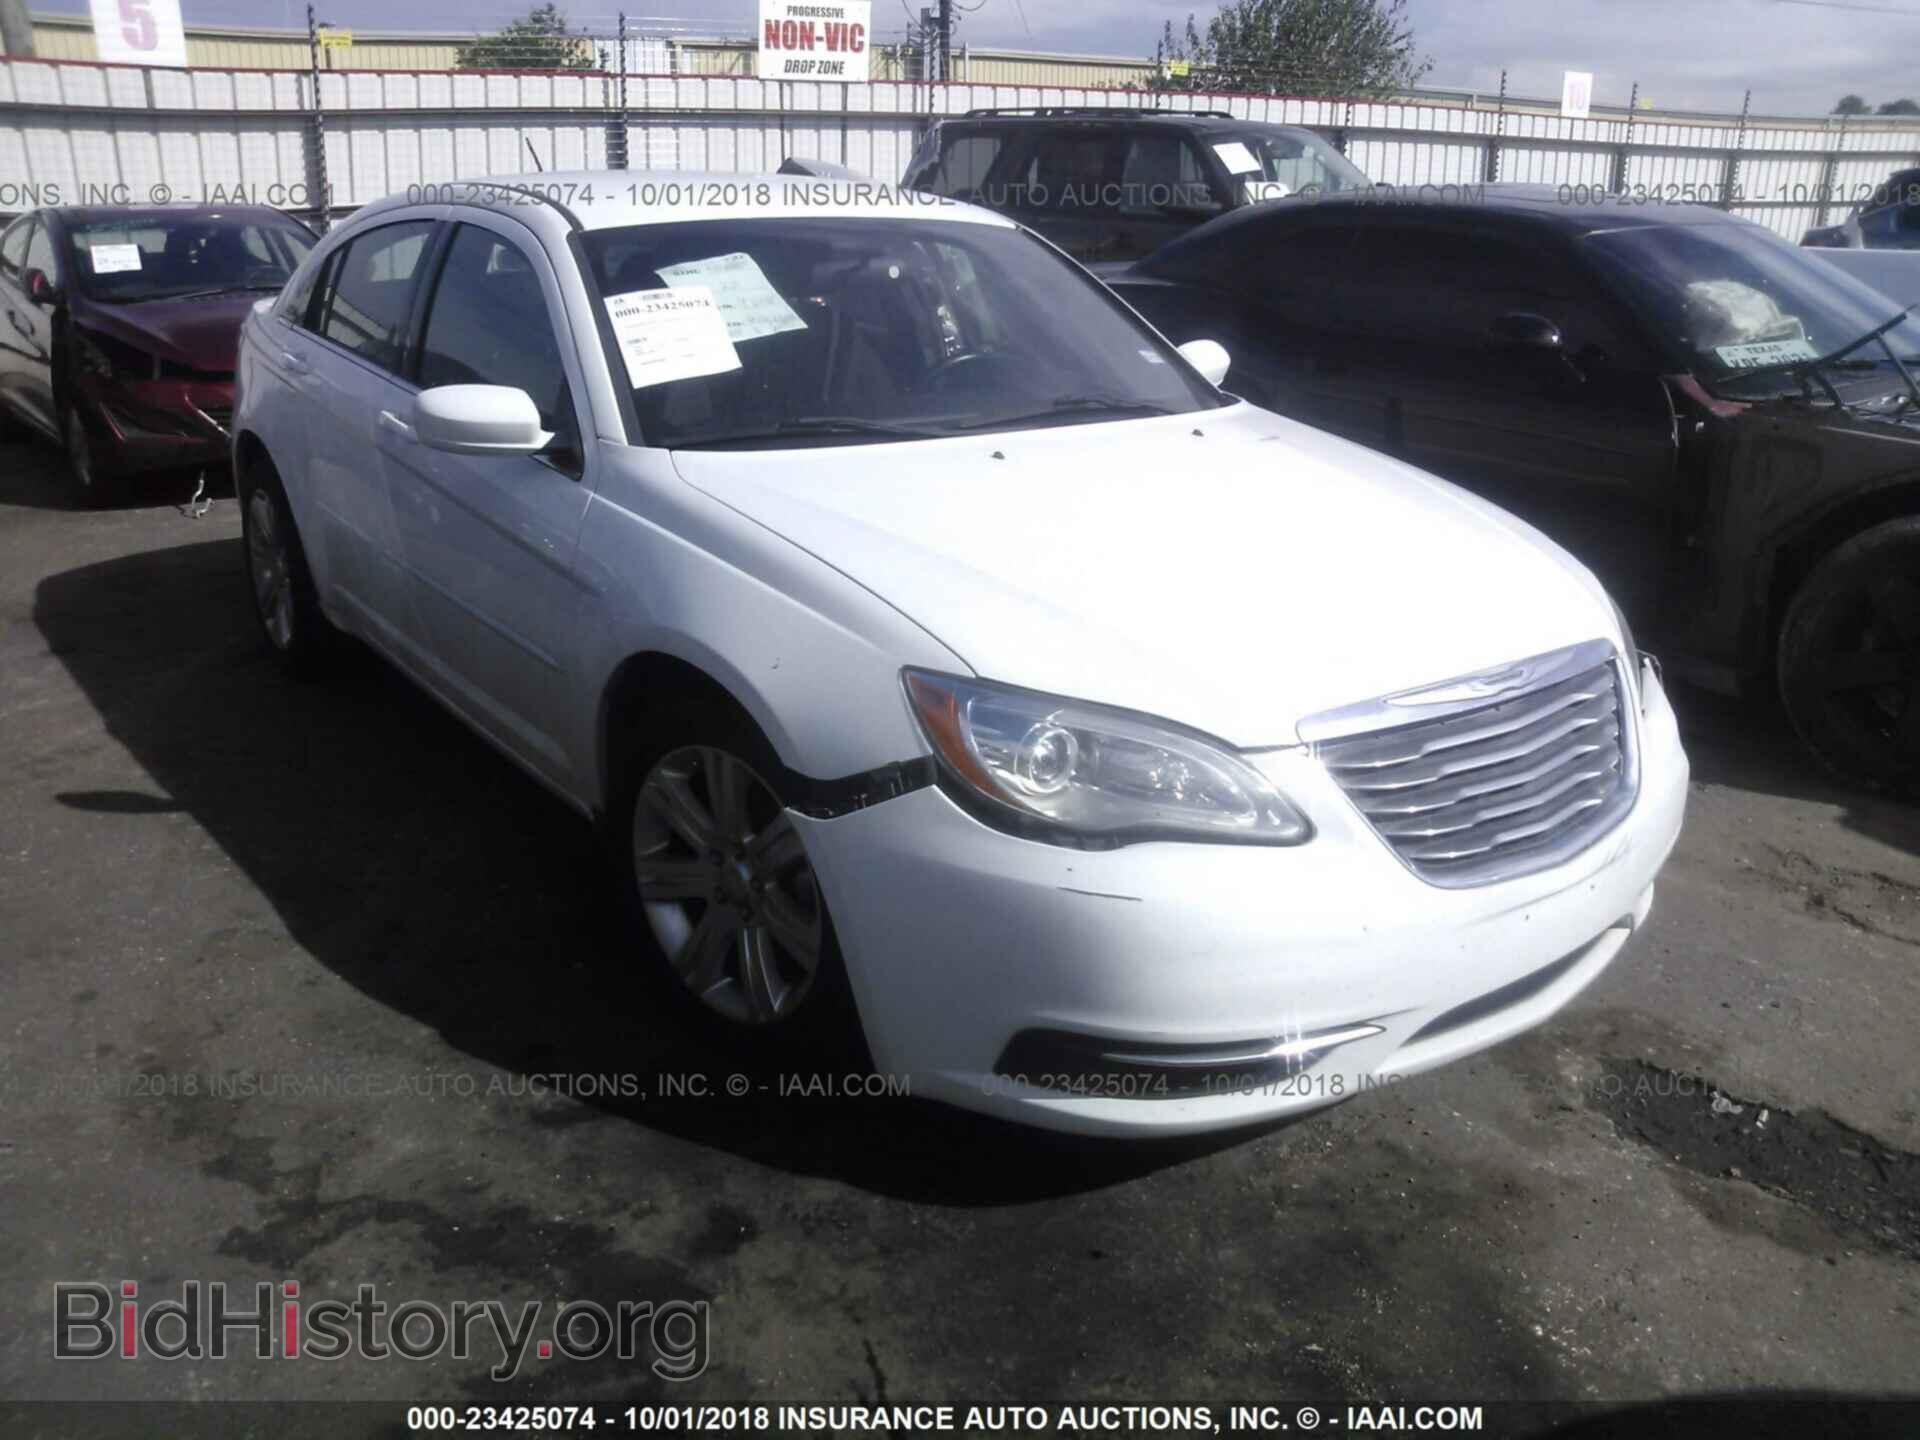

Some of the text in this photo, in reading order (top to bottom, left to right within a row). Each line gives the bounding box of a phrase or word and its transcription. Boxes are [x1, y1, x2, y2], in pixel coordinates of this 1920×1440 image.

[786, 5, 845, 18] PROGRESSIVE
[764, 18, 865, 53] NON-VIC
[784, 59, 845, 75] DROP ZONE
